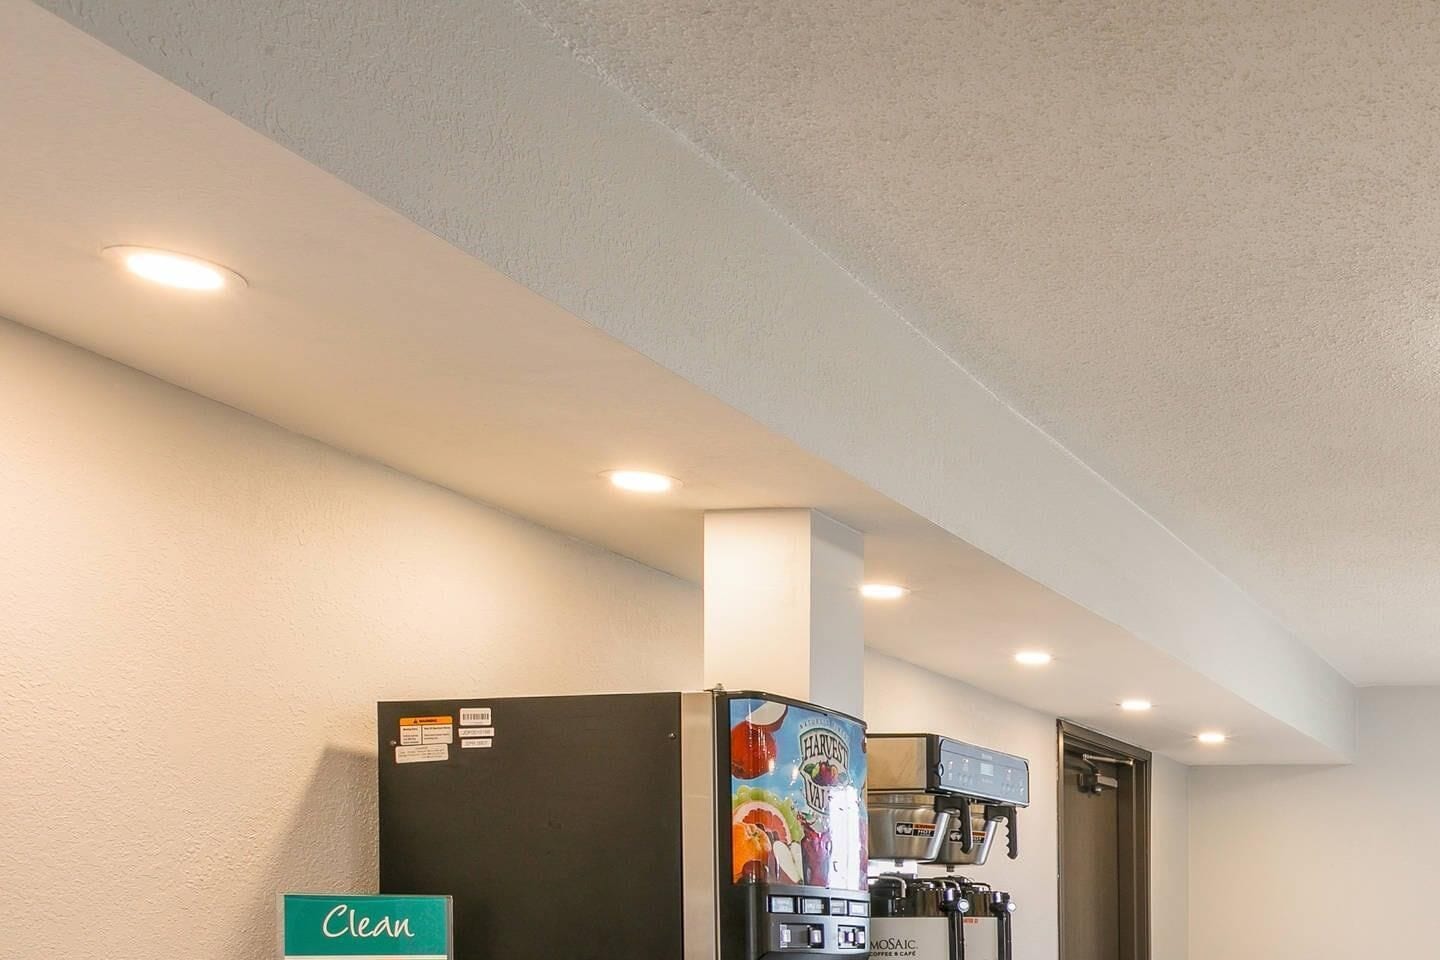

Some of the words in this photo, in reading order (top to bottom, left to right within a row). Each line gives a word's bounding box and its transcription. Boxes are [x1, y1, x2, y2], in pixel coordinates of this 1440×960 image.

[804, 734, 848, 770] HARVEST
[322, 904, 415, 938] Clean
[870, 938, 916, 950] MOSAIC
